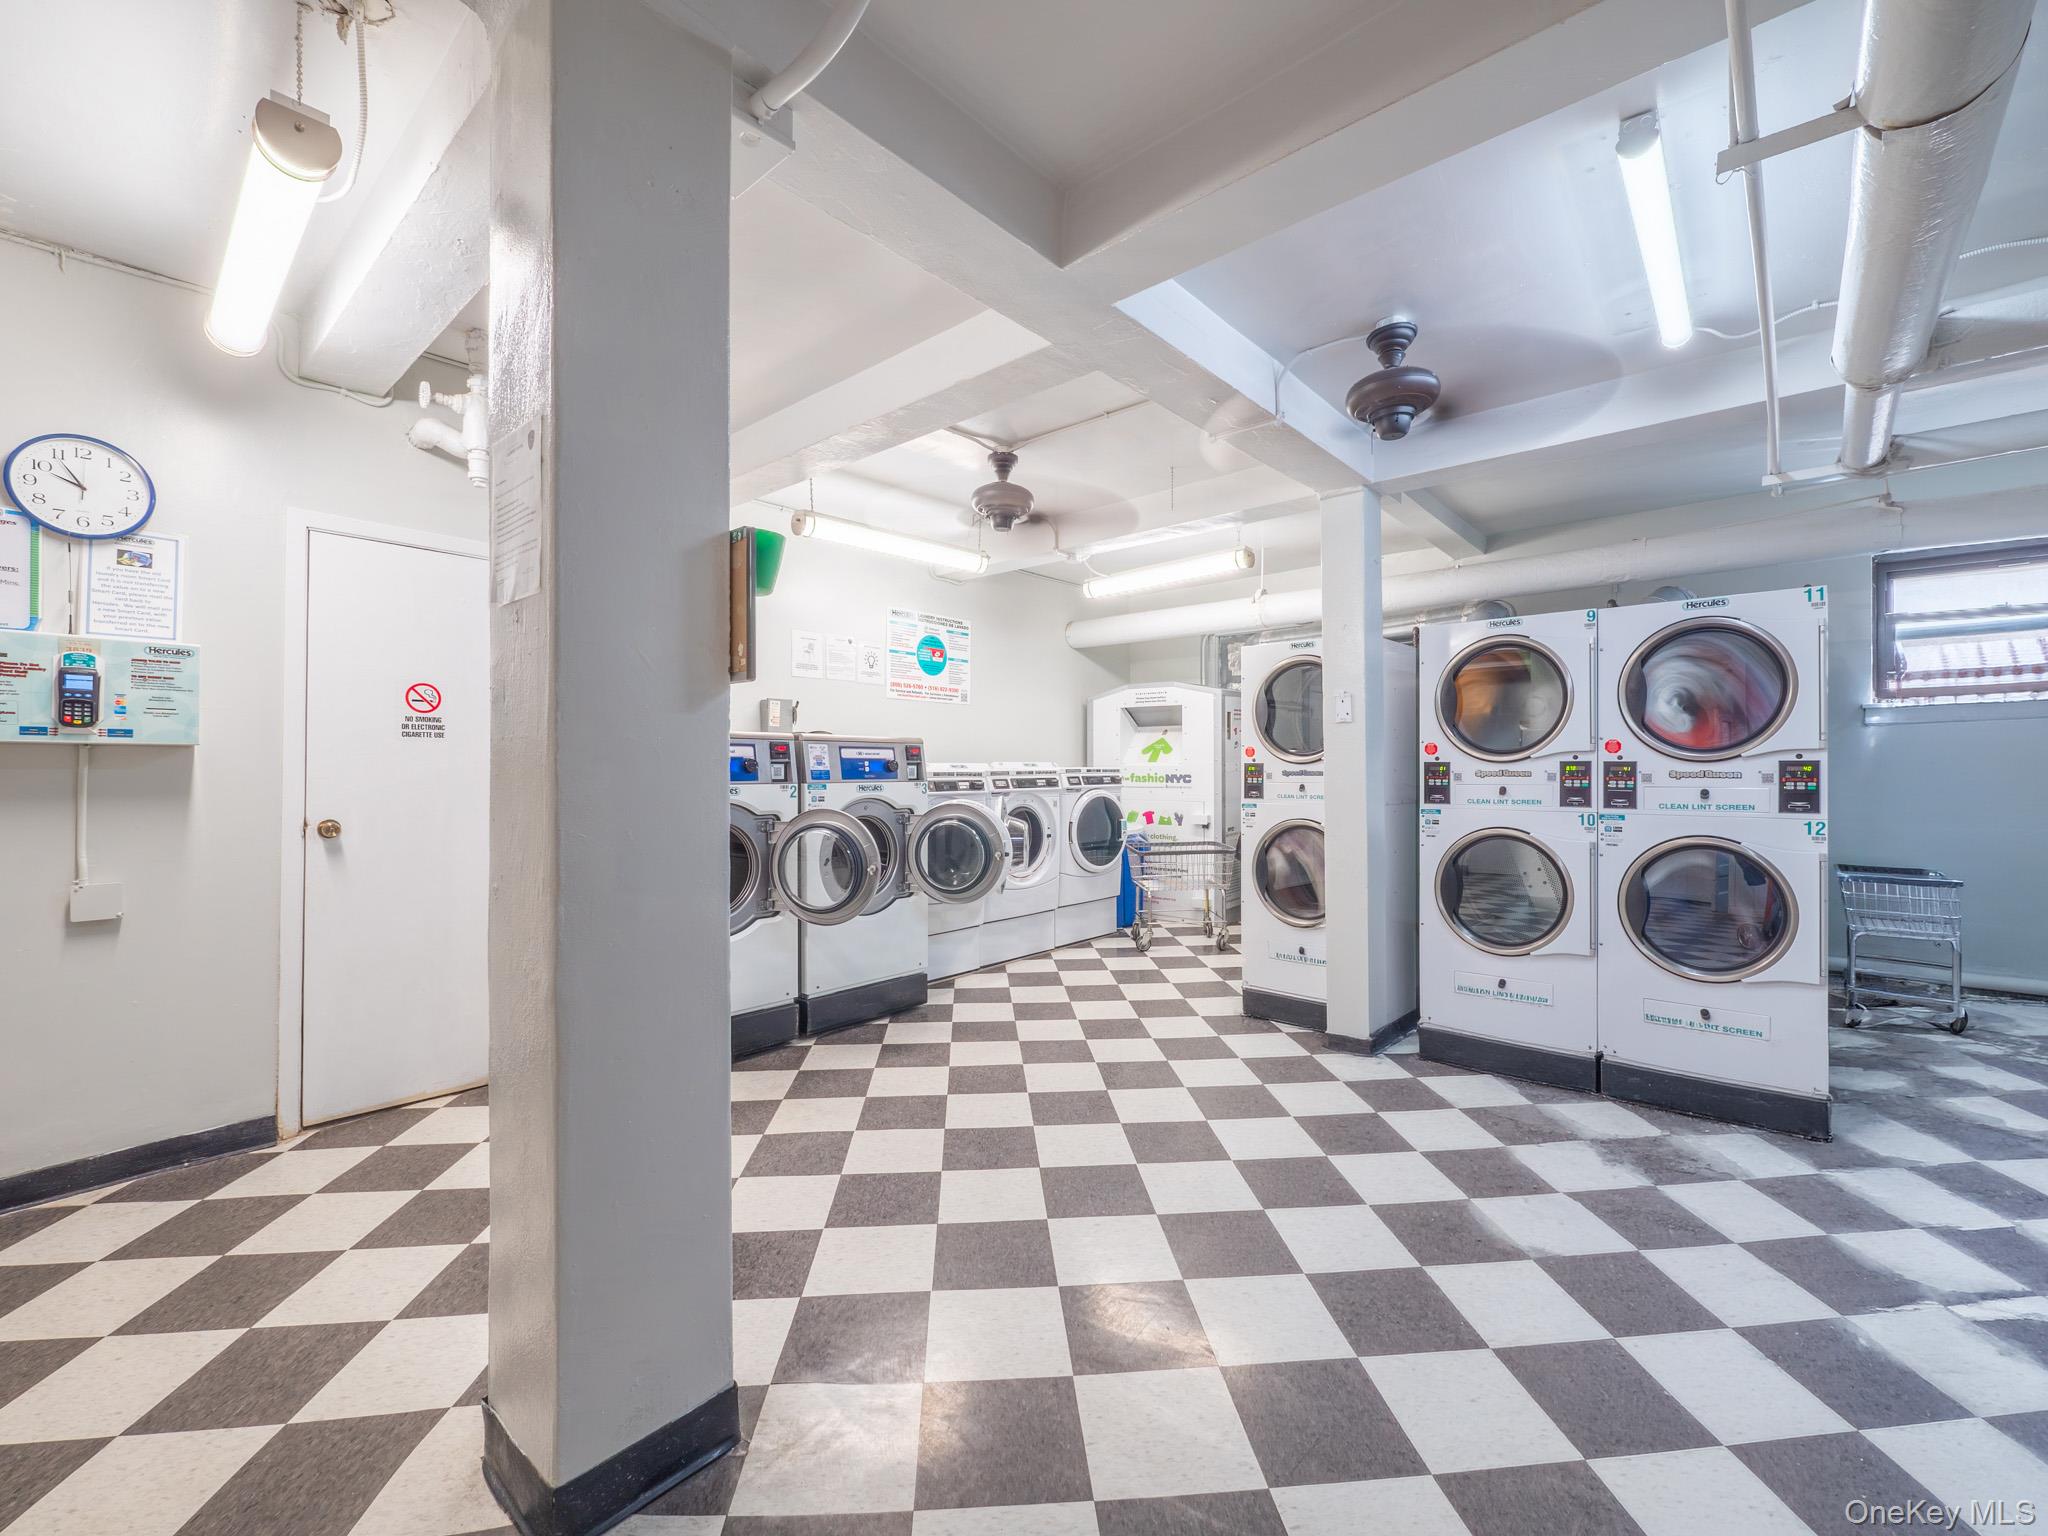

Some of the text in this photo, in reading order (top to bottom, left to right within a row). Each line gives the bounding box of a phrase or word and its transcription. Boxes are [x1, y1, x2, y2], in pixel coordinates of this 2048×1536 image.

[52, 448, 64, 460] 11
[74, 448, 92, 460] 12
[32, 459, 52, 472] 10
[22, 474, 37, 485] 9
[120, 471, 131, 482] 2
[32, 492, 46, 504] 8
[127, 490, 139, 501] 3
[52, 508, 65, 519] 7
[118, 506, 131, 516] 4
[76, 516, 90, 527] 6
[101, 514, 114, 526] 5
[1803, 587, 1824, 602] 11
[1686, 599, 1726, 609] Hercules
[1586, 610, 1596, 622] 9
[1489, 619, 1521, 627] Hercules
[148, 646, 191, 656] Hercules
[1475, 770, 1502, 778] Speed
[1669, 770, 1742, 780] Speed Queen
[790, 785, 797, 798] 2
[922, 783, 927, 794] 3
[1578, 813, 1595, 826] 10
[1803, 821, 1826, 836] 12
[1722, 1026, 1763, 1038] SCREEN
